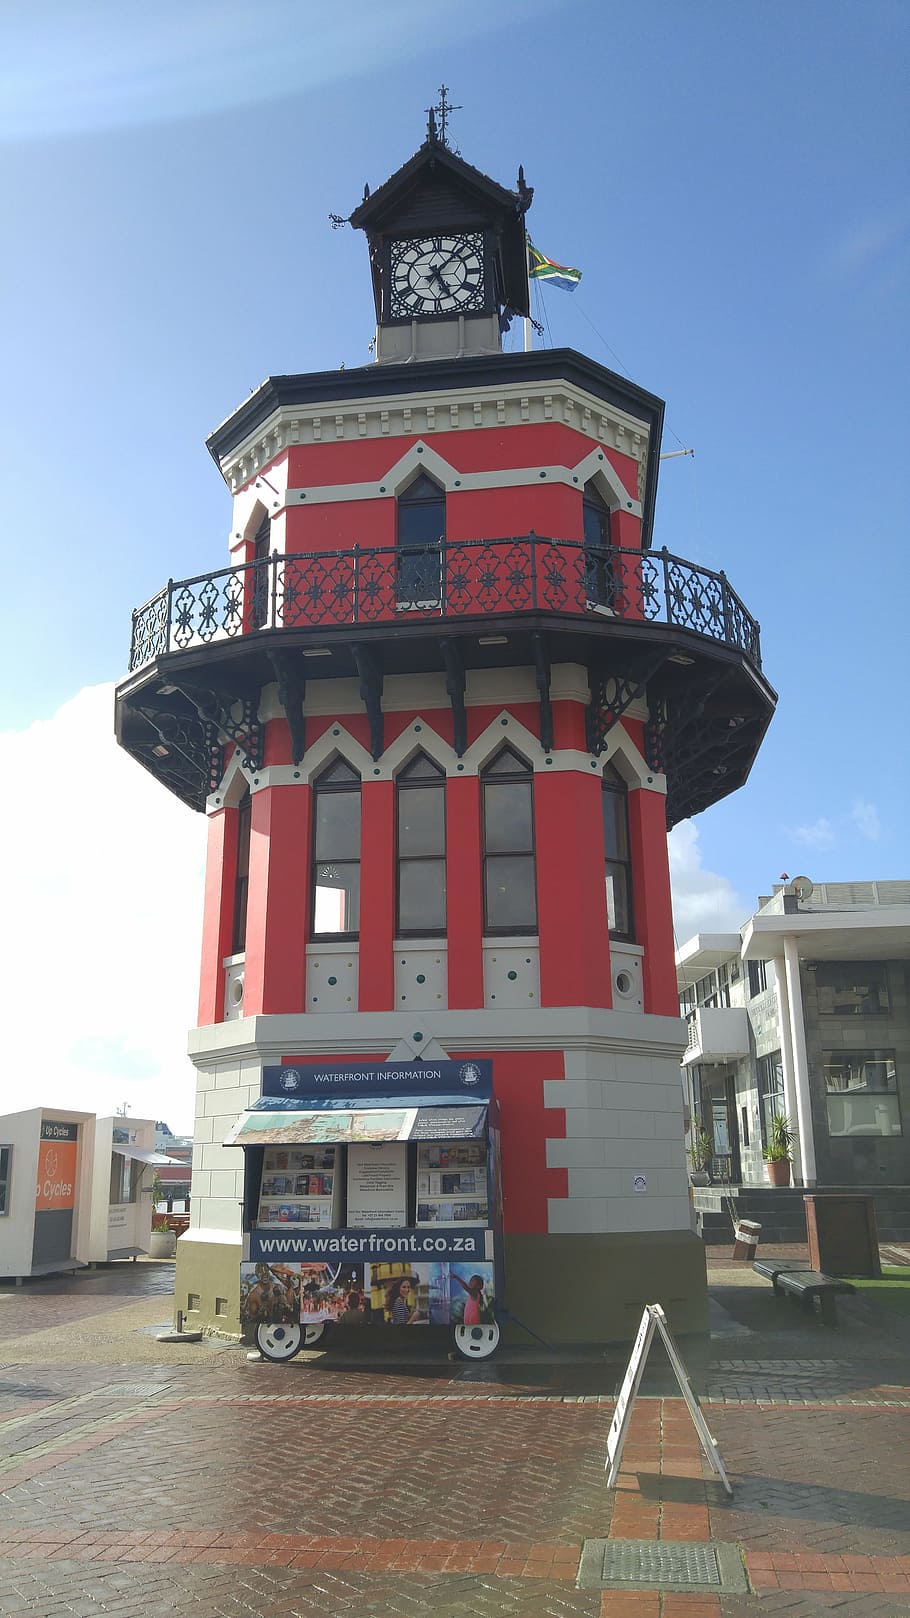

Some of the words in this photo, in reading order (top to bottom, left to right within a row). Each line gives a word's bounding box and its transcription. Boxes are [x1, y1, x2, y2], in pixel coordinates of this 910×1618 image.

[313, 1072, 374, 1082] WATERFRONT
[376, 1070, 441, 1081] INFORMATION
[45, 1125, 53, 1136] Up
[54, 1126, 69, 1137] Cycles
[43, 1180, 72, 1201] Cycles
[259, 1234, 476, 1252] www.waterfront.co.za
